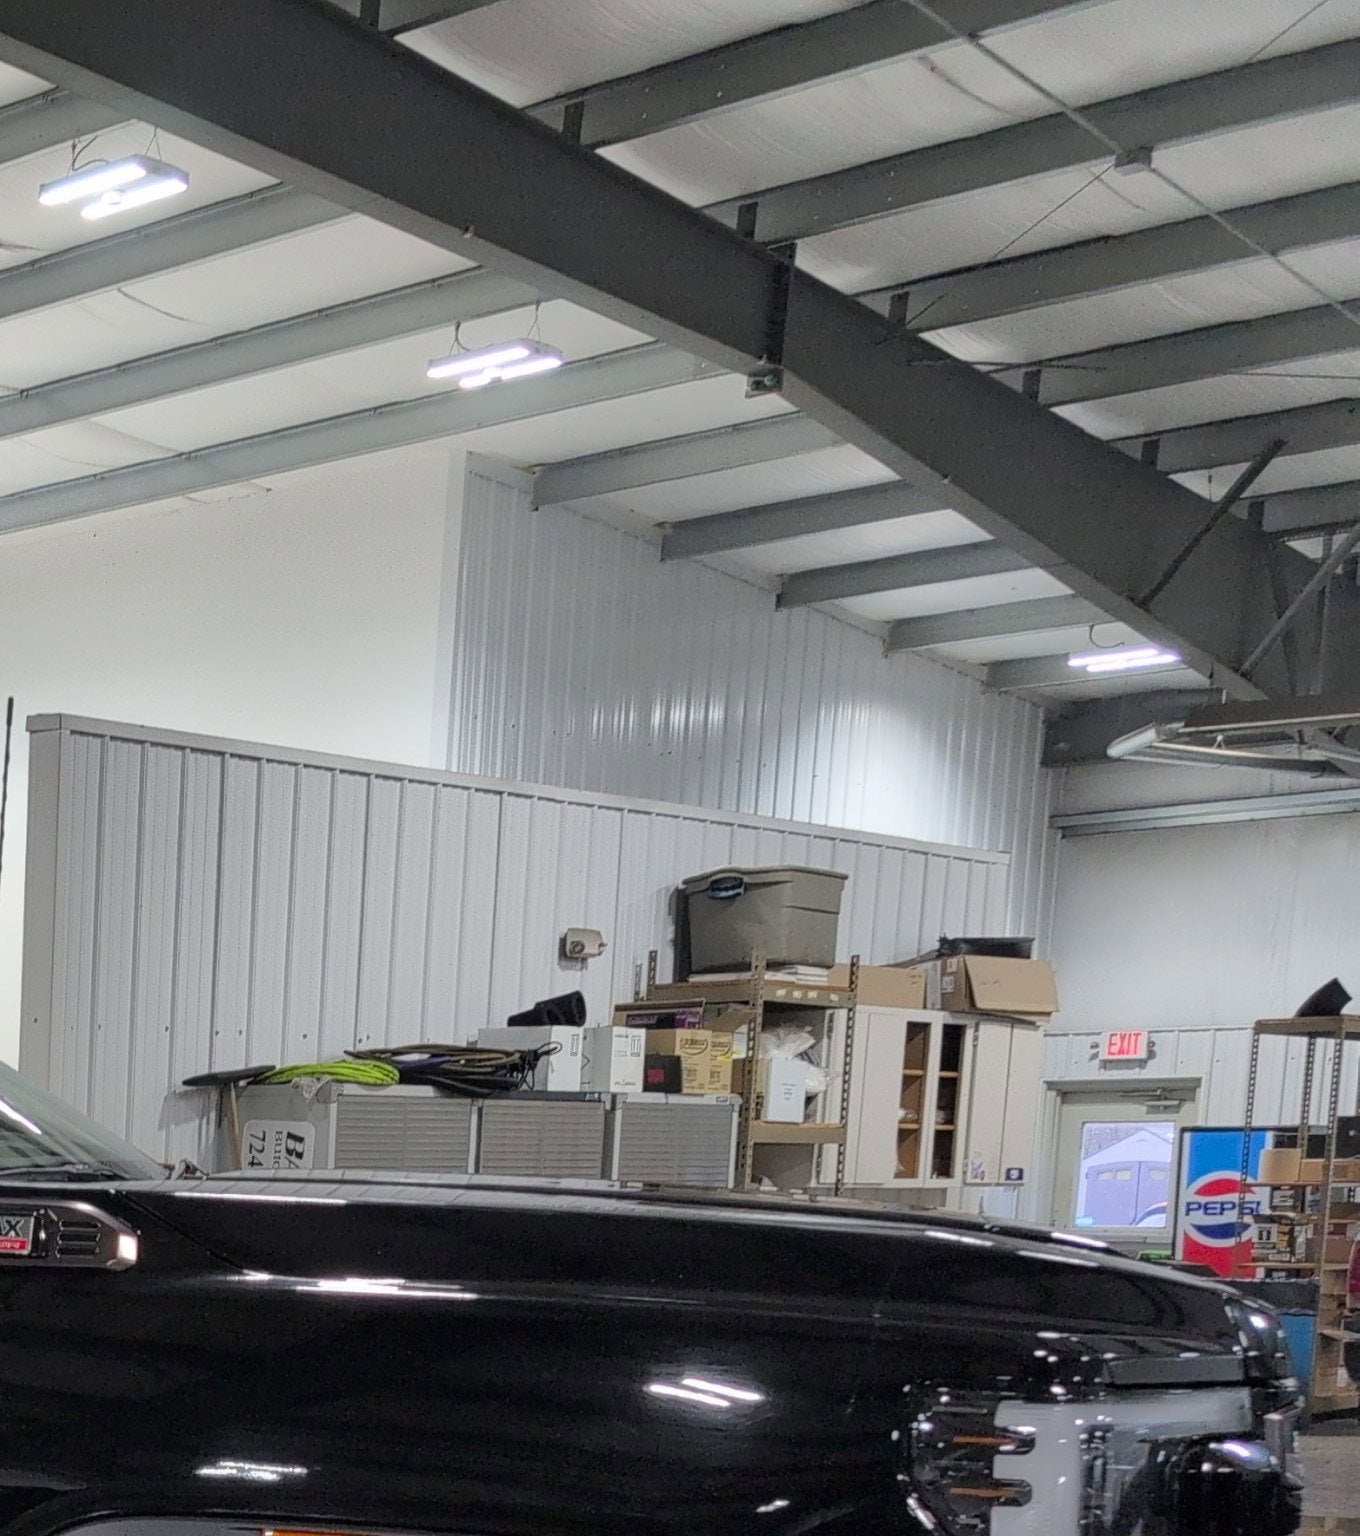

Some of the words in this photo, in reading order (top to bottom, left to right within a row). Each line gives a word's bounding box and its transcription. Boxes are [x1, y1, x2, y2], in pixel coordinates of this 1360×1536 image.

[1108, 1032, 1142, 1056] EXIT
[248, 1130, 266, 1168] 724
[1184, 1200, 1261, 1217] PEPSI
